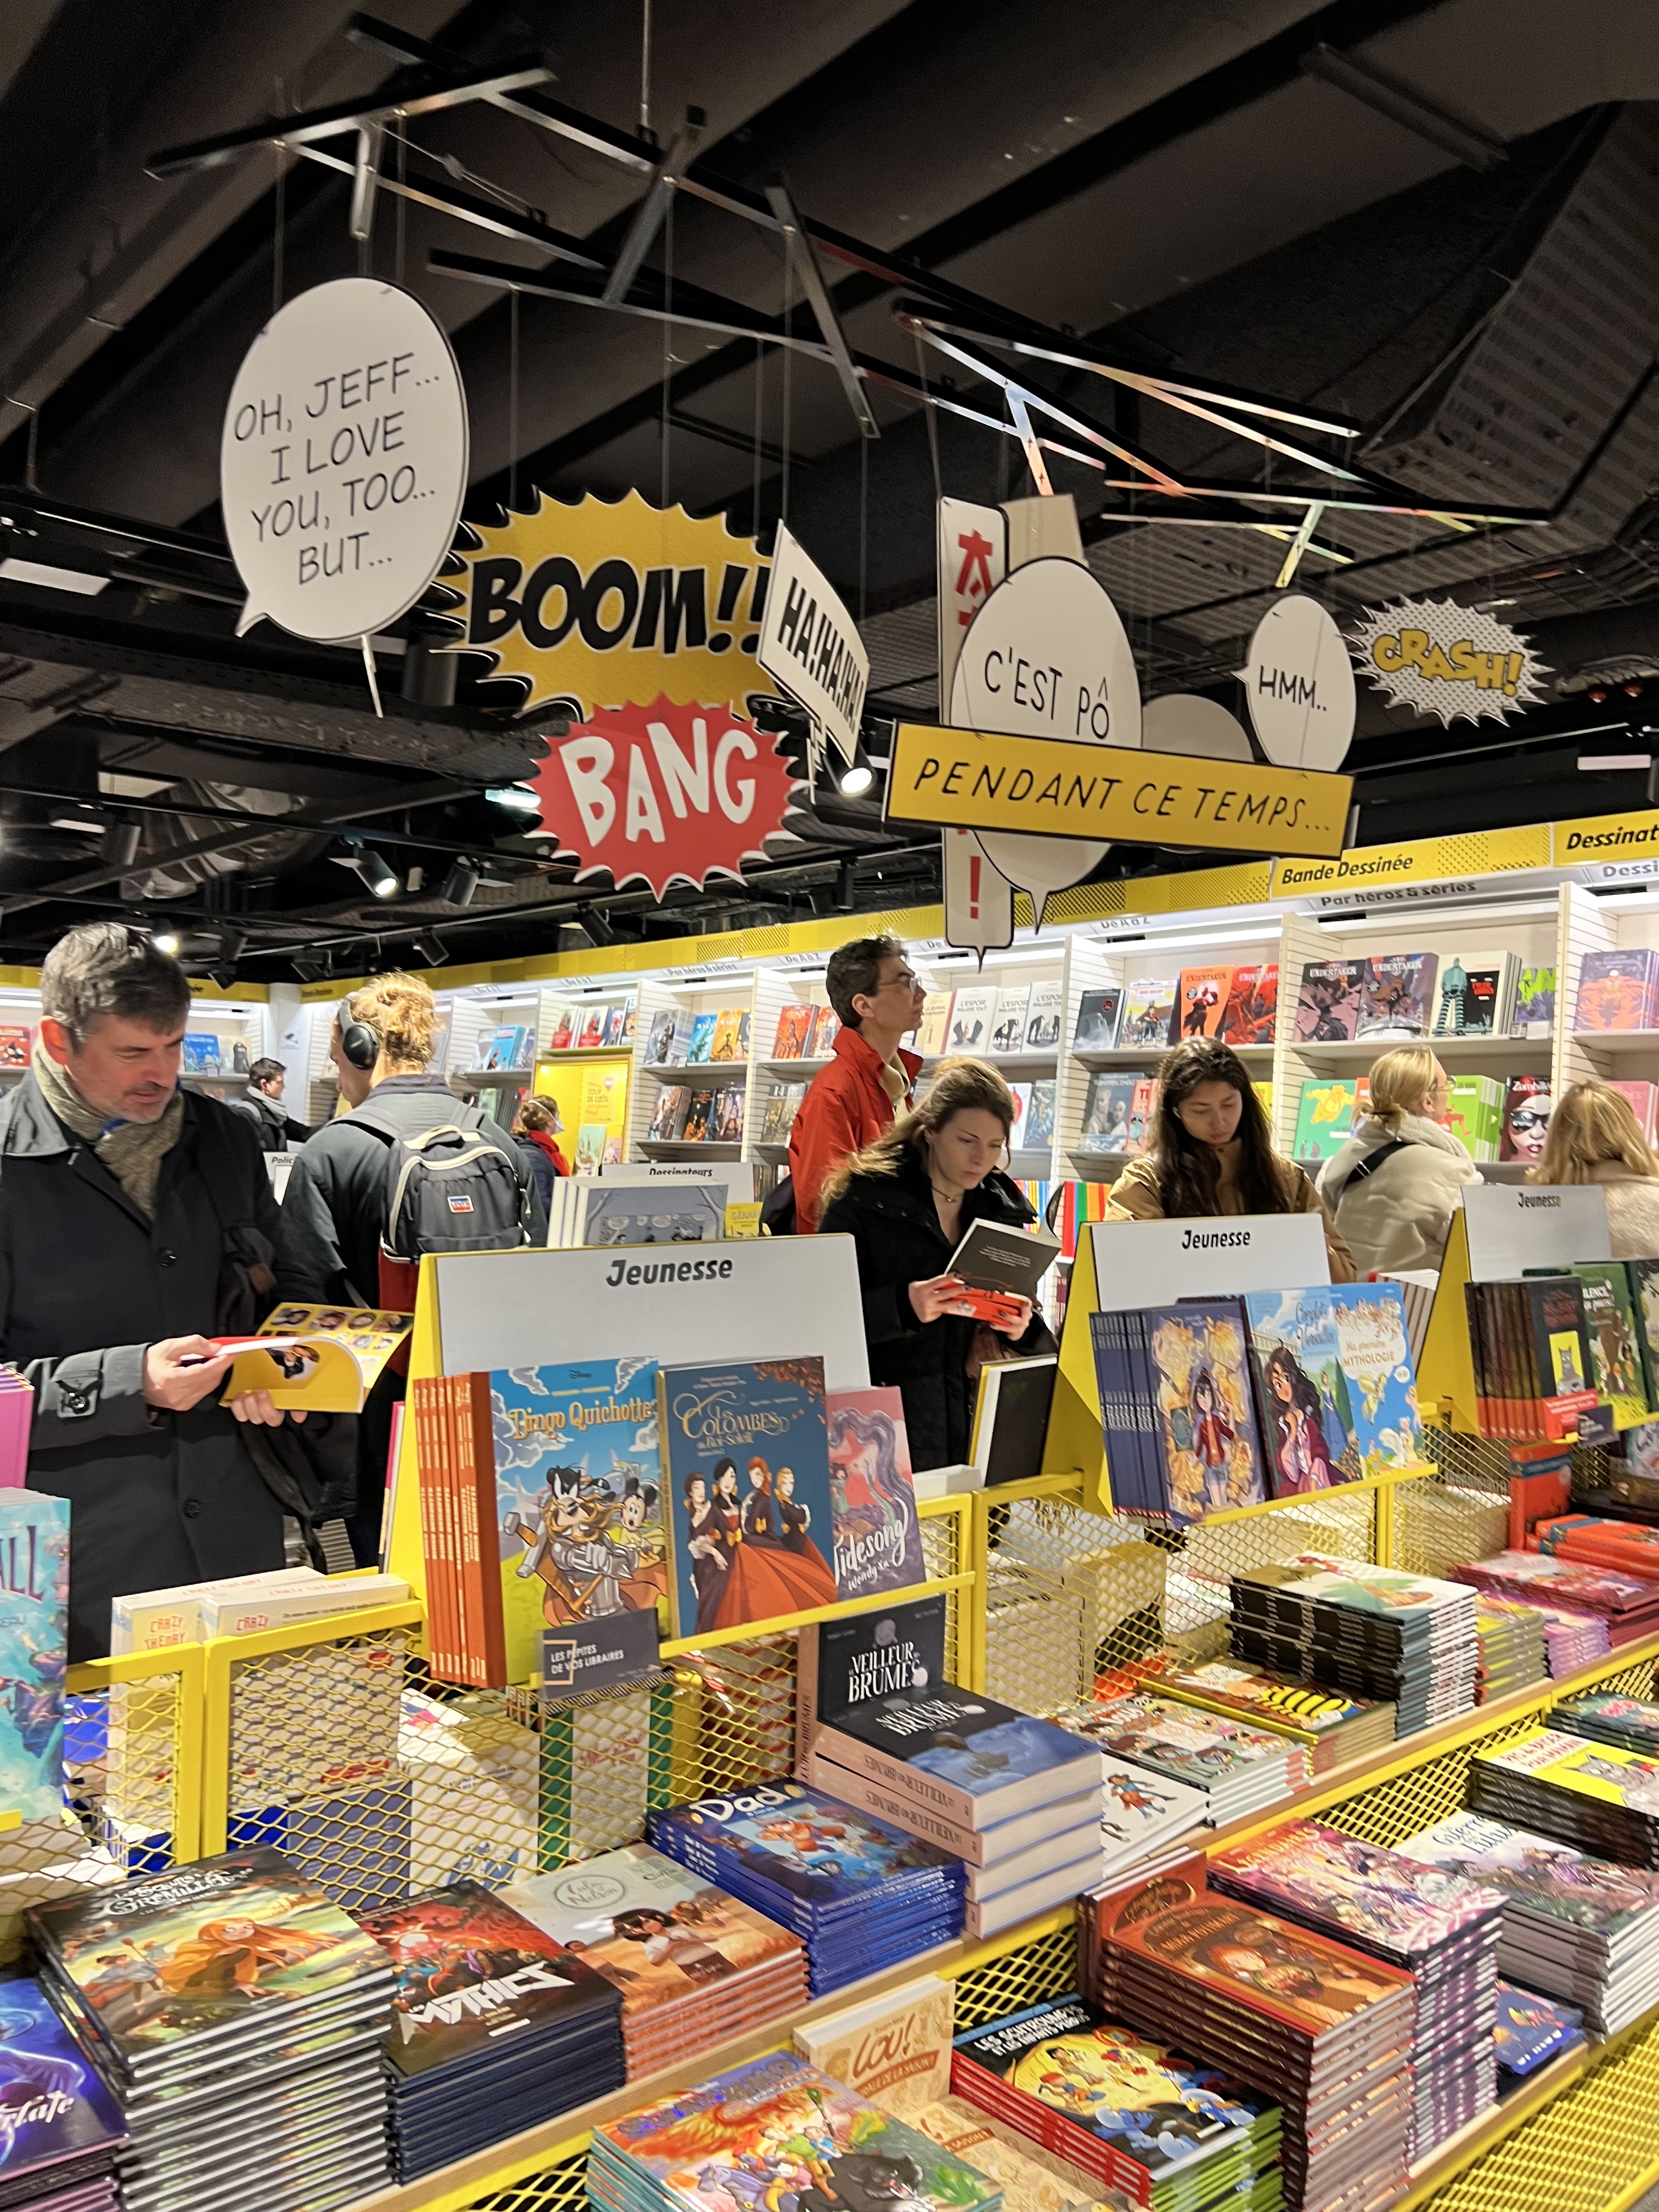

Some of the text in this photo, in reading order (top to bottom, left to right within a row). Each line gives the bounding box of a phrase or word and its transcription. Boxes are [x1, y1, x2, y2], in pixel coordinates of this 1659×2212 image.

[234, 352, 440, 441] OH, JEFF...
[271, 410, 405, 484] I LOVE
[251, 465, 436, 542] YOU, TOO...
[298, 532, 392, 585] BUT...
[467, 556, 770, 654] BOOM!!
[1372, 628, 1526, 697] CRASH!
[984, 646, 1110, 740] C'EST PÔ
[1259, 666, 1328, 713] HMM..
[558, 718, 758, 848] BANG
[913, 758, 1330, 832] PENDANT CE TEMPS...
[1566, 824, 1659, 850] Dessinat
[1282, 854, 1414, 885] Bande Dessinée
[1603, 860, 1659, 877] Dessi
[1321, 881, 1476, 907] Par héros & séries
[668, 968, 682, 977] Par
[785, 955, 798, 964] De
[1517, 1192, 1561, 1208] Jeunesse
[1182, 1229, 1251, 1249] Jeunesse
[606, 1259, 733, 1287] Jeunesse
[1344, 1351, 1395, 1367] MYTHOLOGIE
[508, 1396, 653, 1440] Dingo Quichotte
[851, 1641, 914, 1674] VEILLEUR
[688, 1785, 792, 1822] Dad
